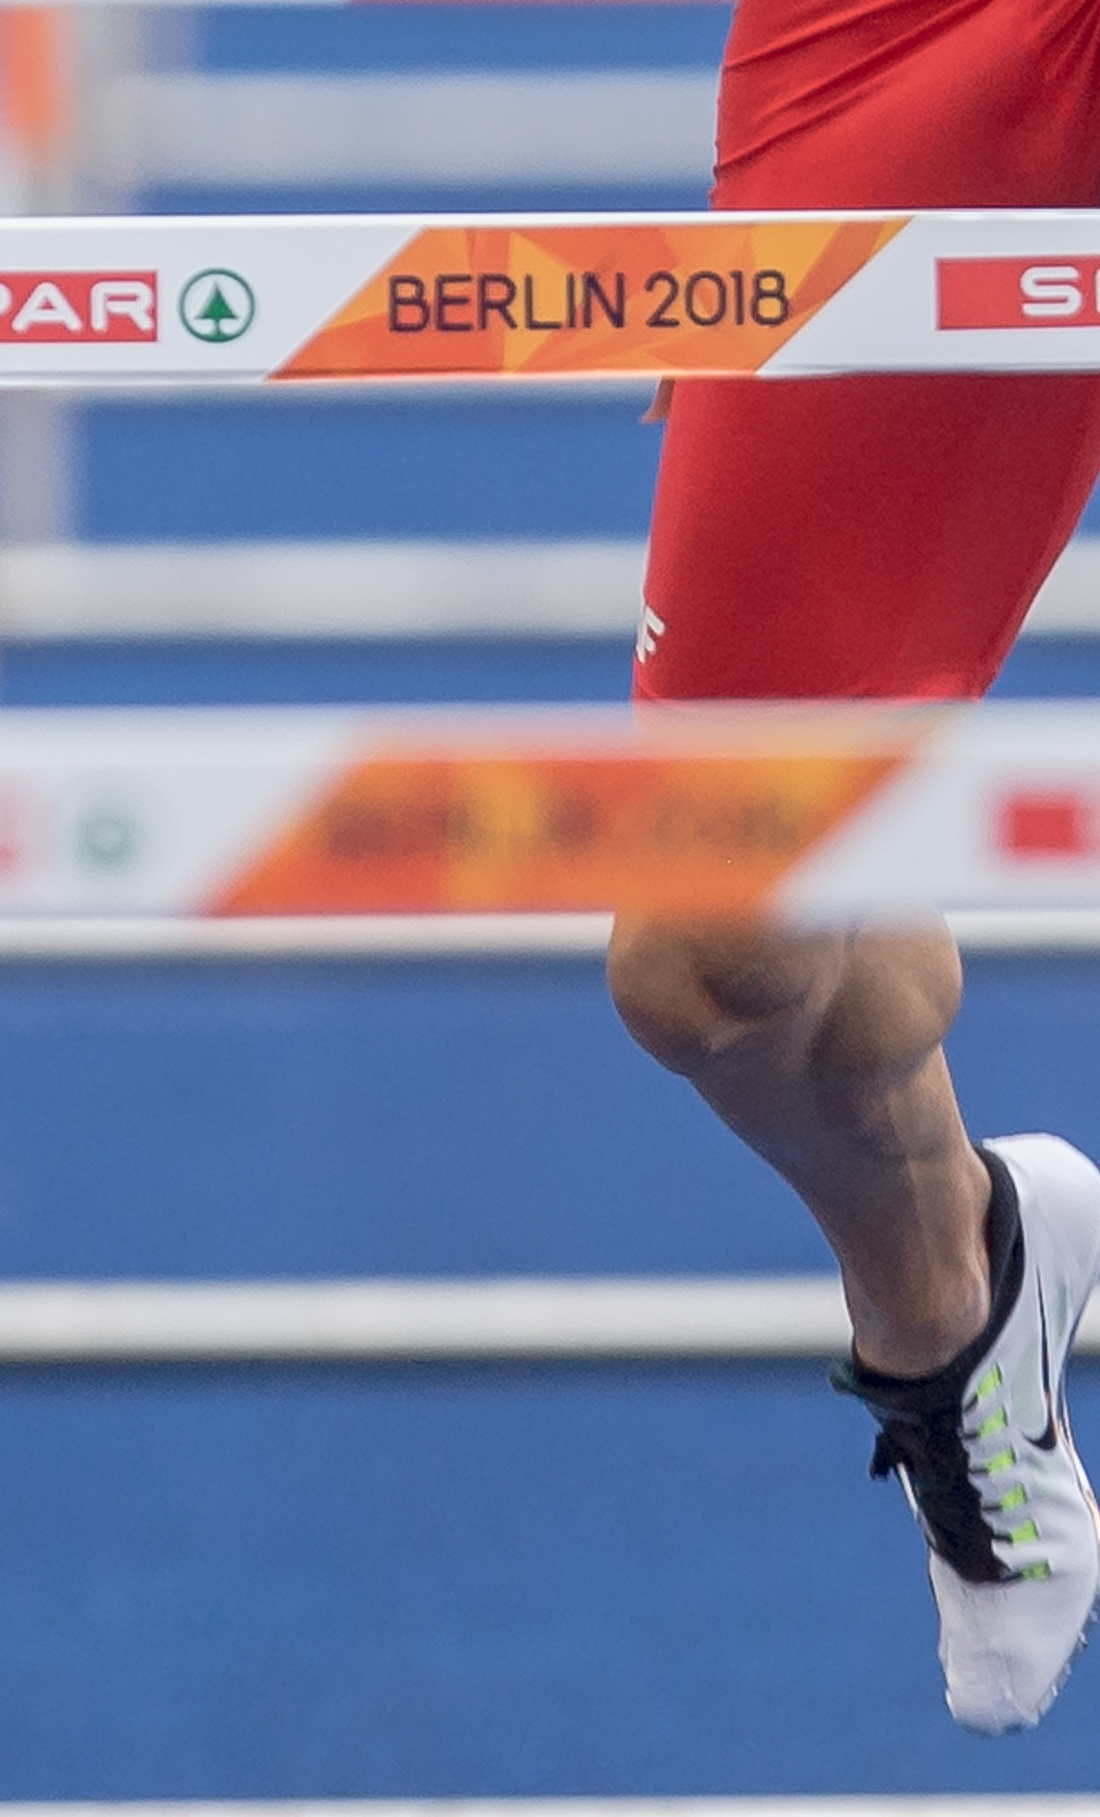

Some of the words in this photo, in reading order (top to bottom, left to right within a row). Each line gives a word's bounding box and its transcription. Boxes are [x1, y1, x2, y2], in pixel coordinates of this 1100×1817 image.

[0, 280, 153, 333] AR
[387, 271, 626, 335] BERLIN
[645, 269, 792, 329] 2018
